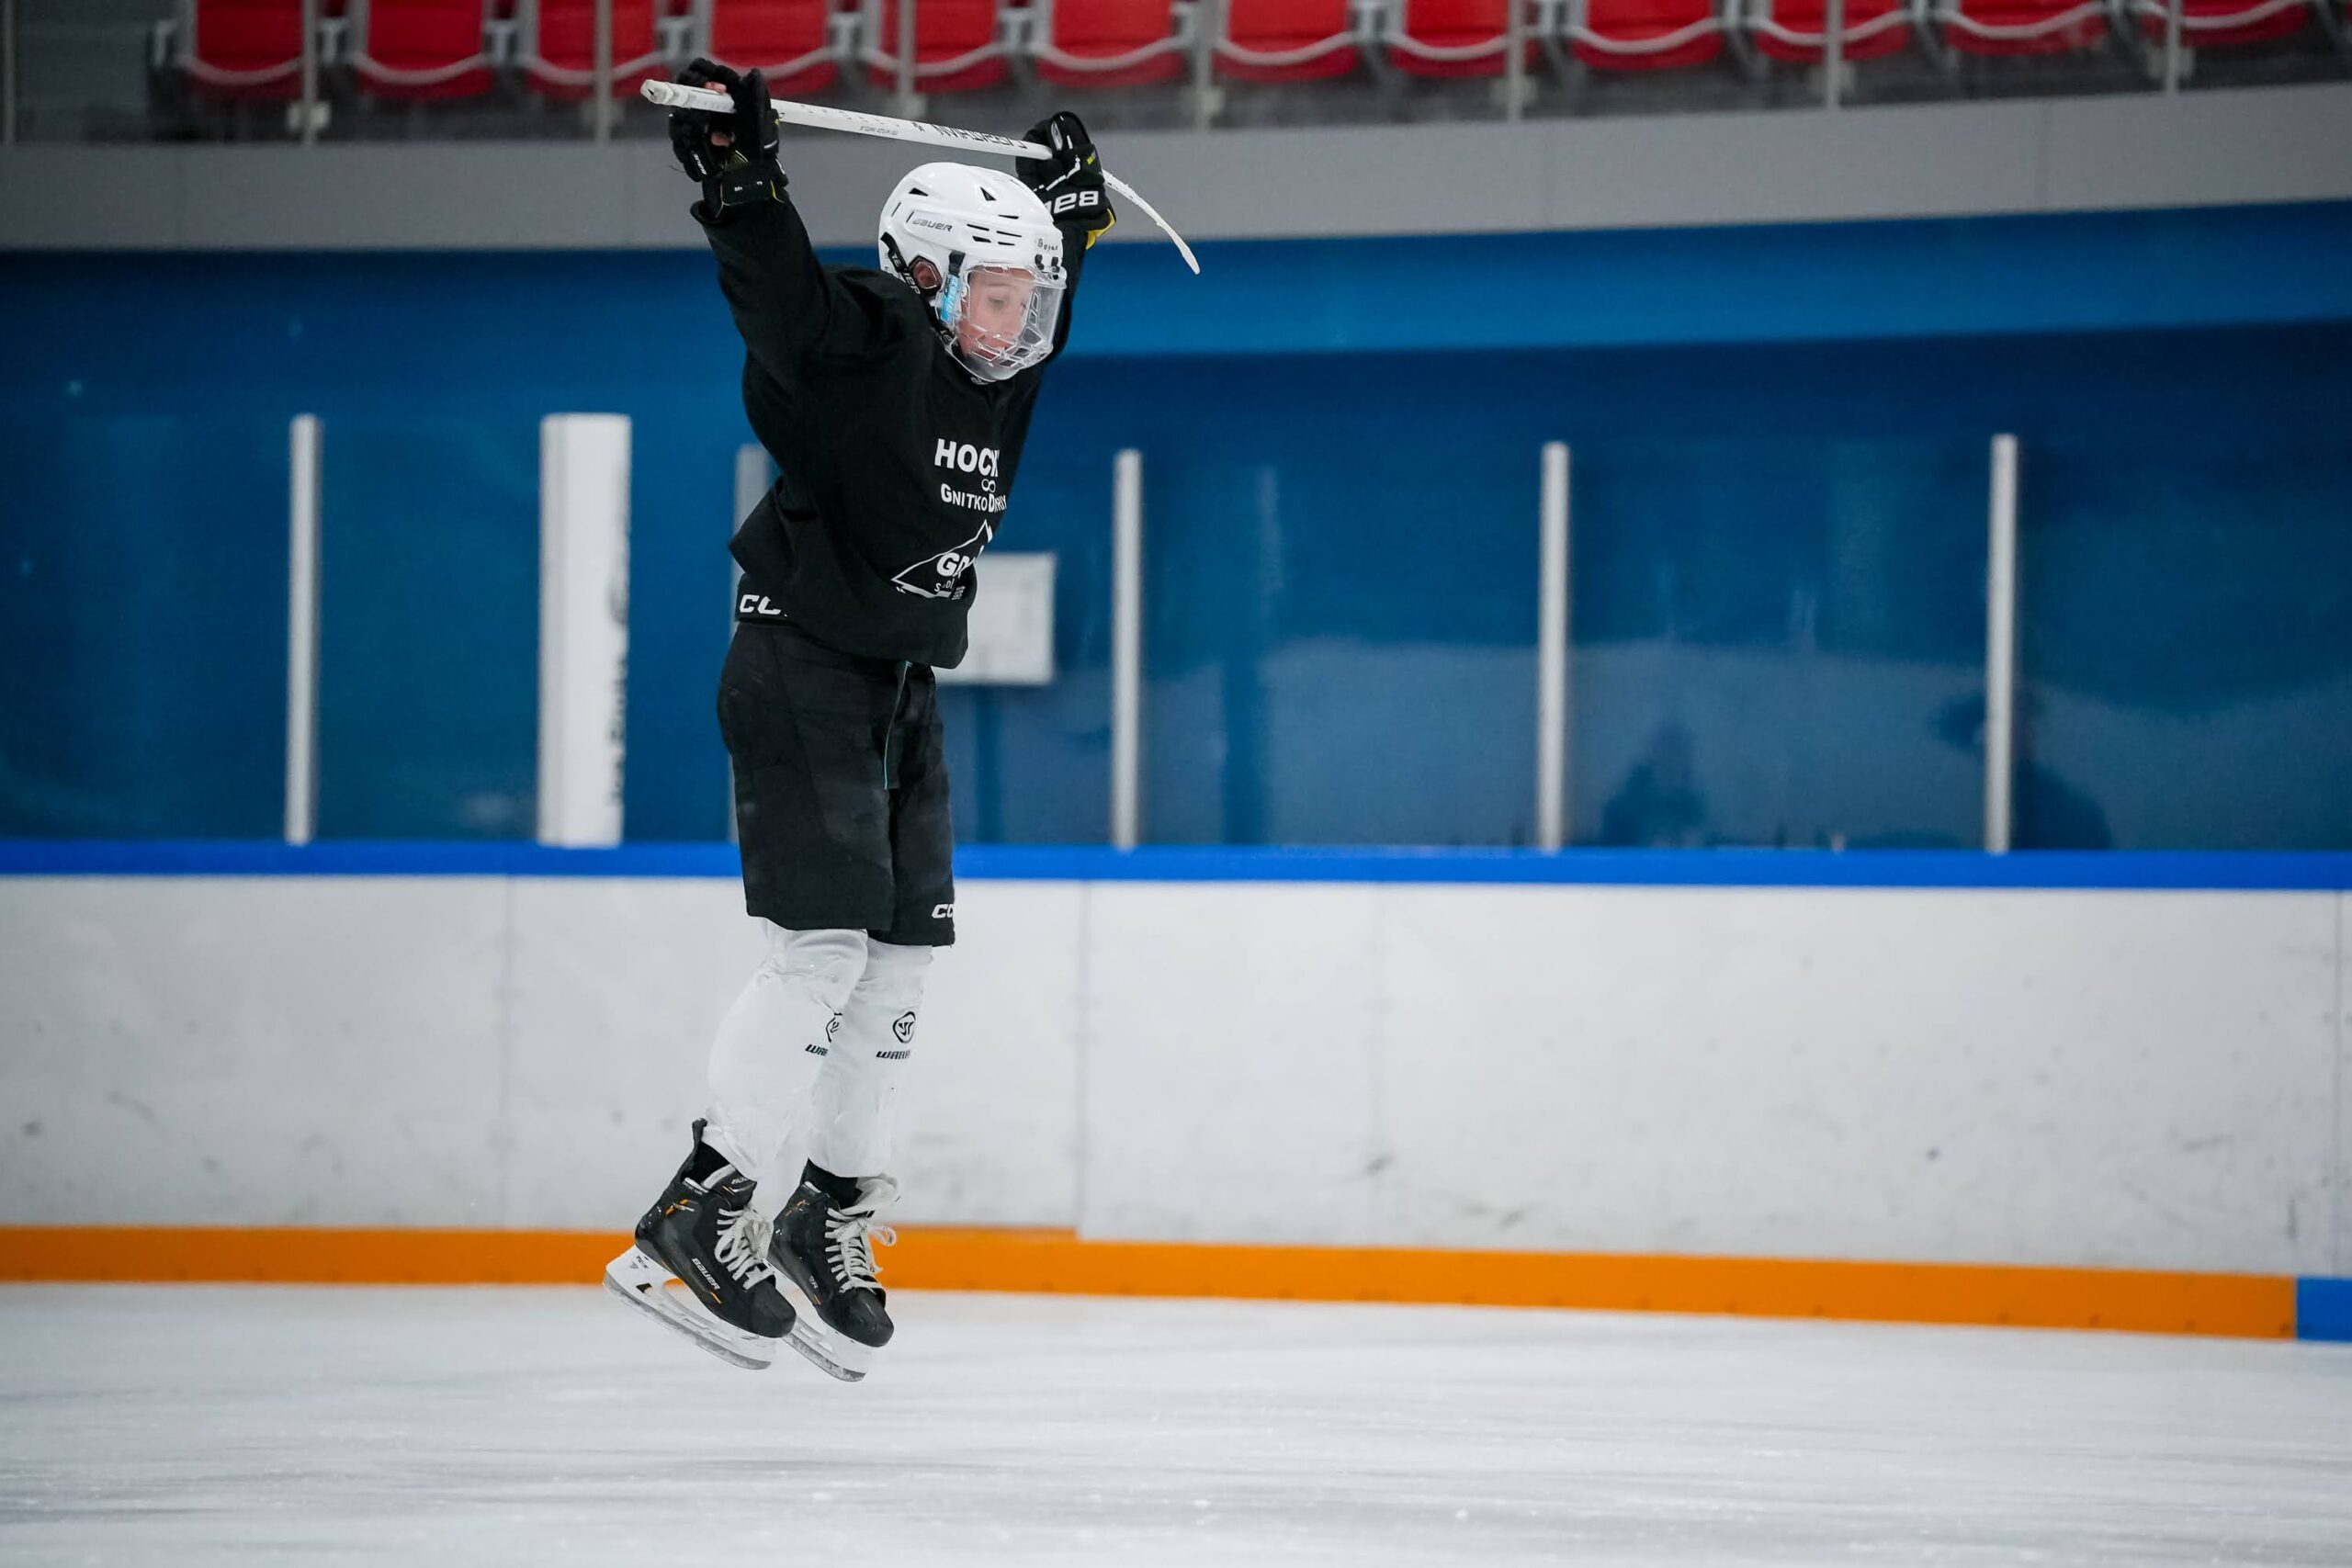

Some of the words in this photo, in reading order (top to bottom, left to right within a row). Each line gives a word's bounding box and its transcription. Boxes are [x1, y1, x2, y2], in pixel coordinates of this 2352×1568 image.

[912, 218, 953, 232] BAUER
[940, 482, 988, 512] GNITKO
[692, 1257, 721, 1291] BAUER
